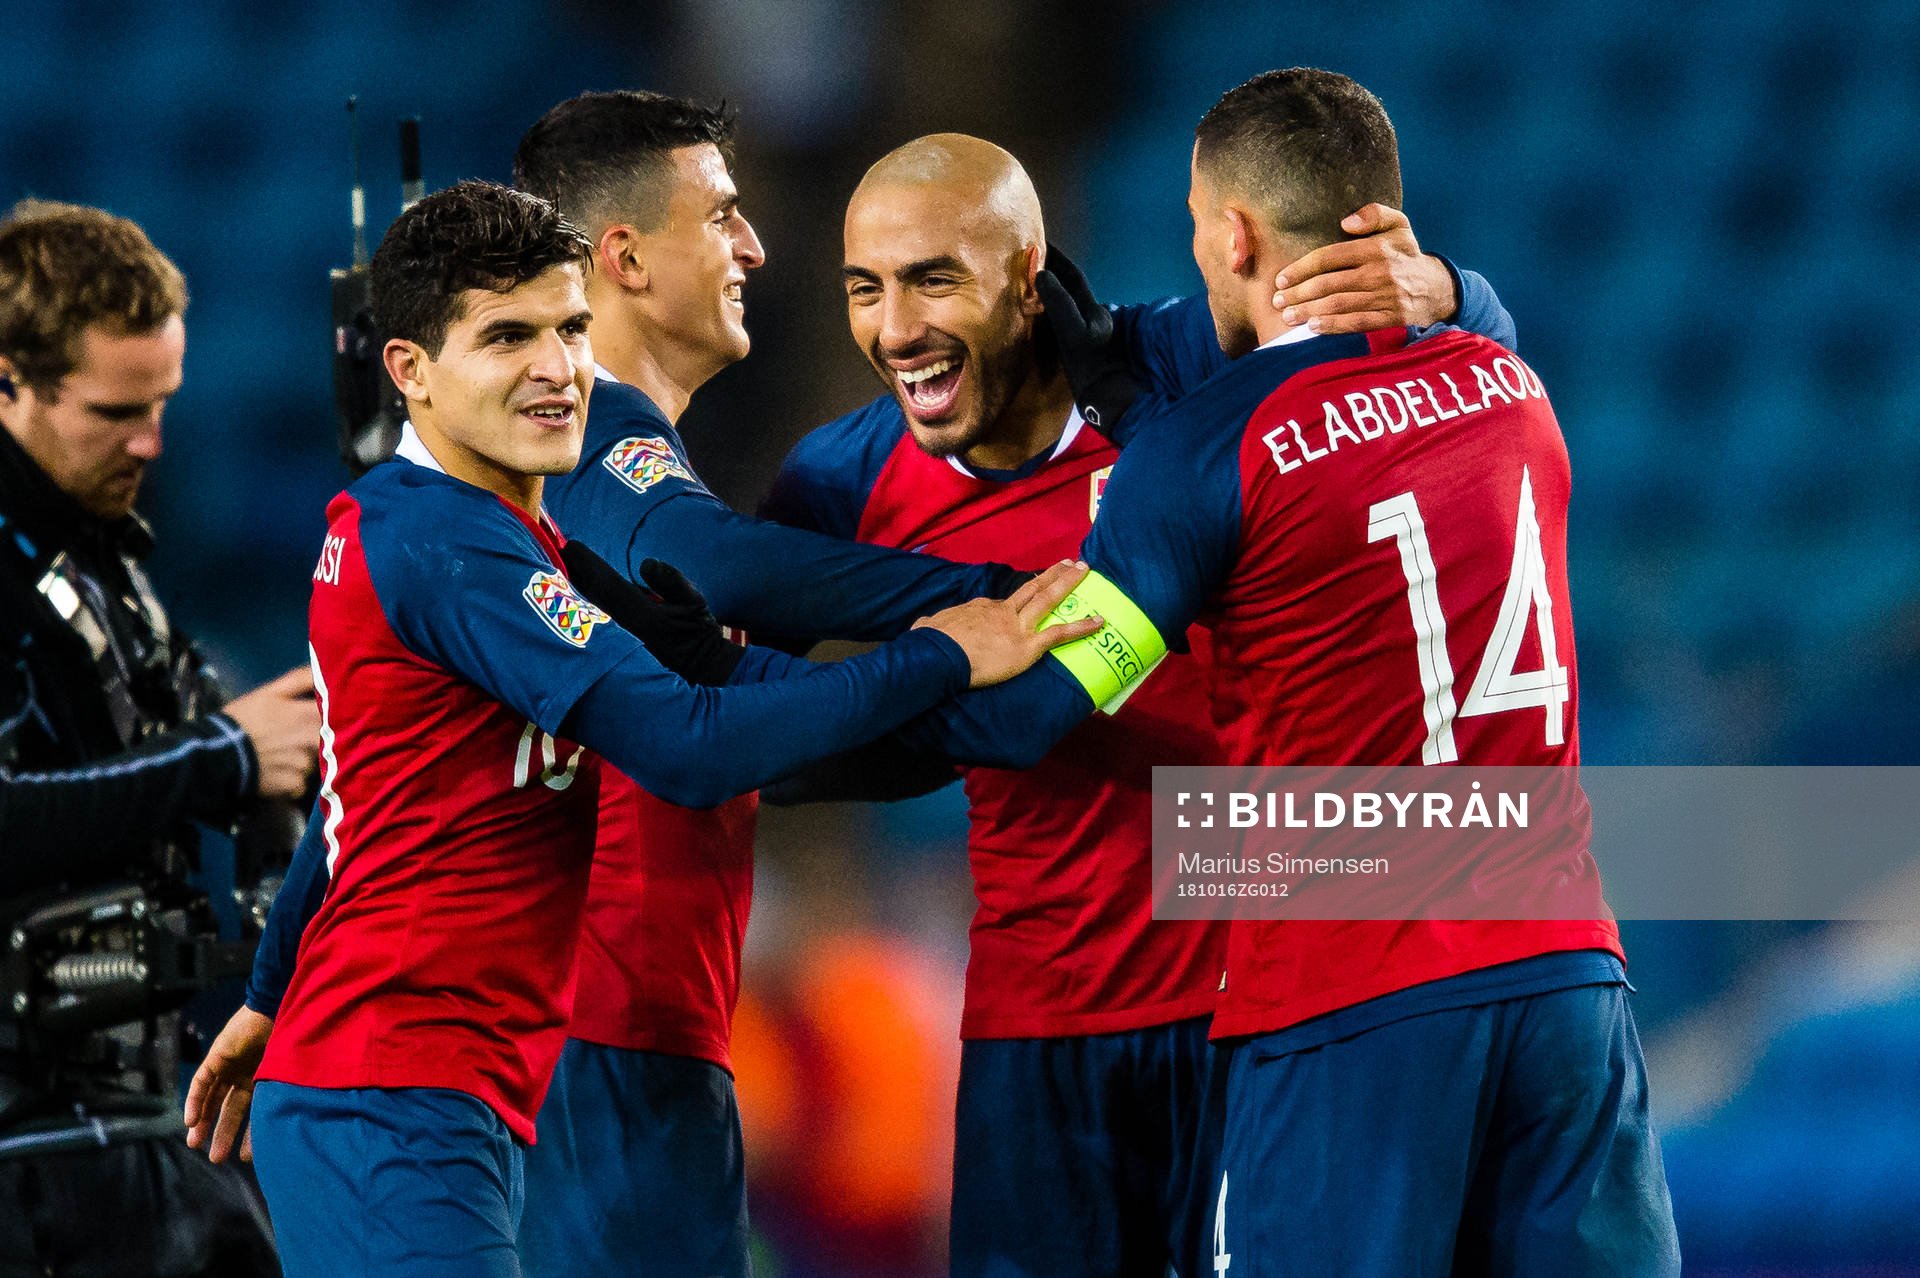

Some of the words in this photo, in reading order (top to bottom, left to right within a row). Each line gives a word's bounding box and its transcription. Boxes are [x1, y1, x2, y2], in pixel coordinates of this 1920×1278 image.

[313, 534, 346, 586] SSI
[1086, 614, 1139, 682] SPECT
[1367, 463, 1569, 766] 14
